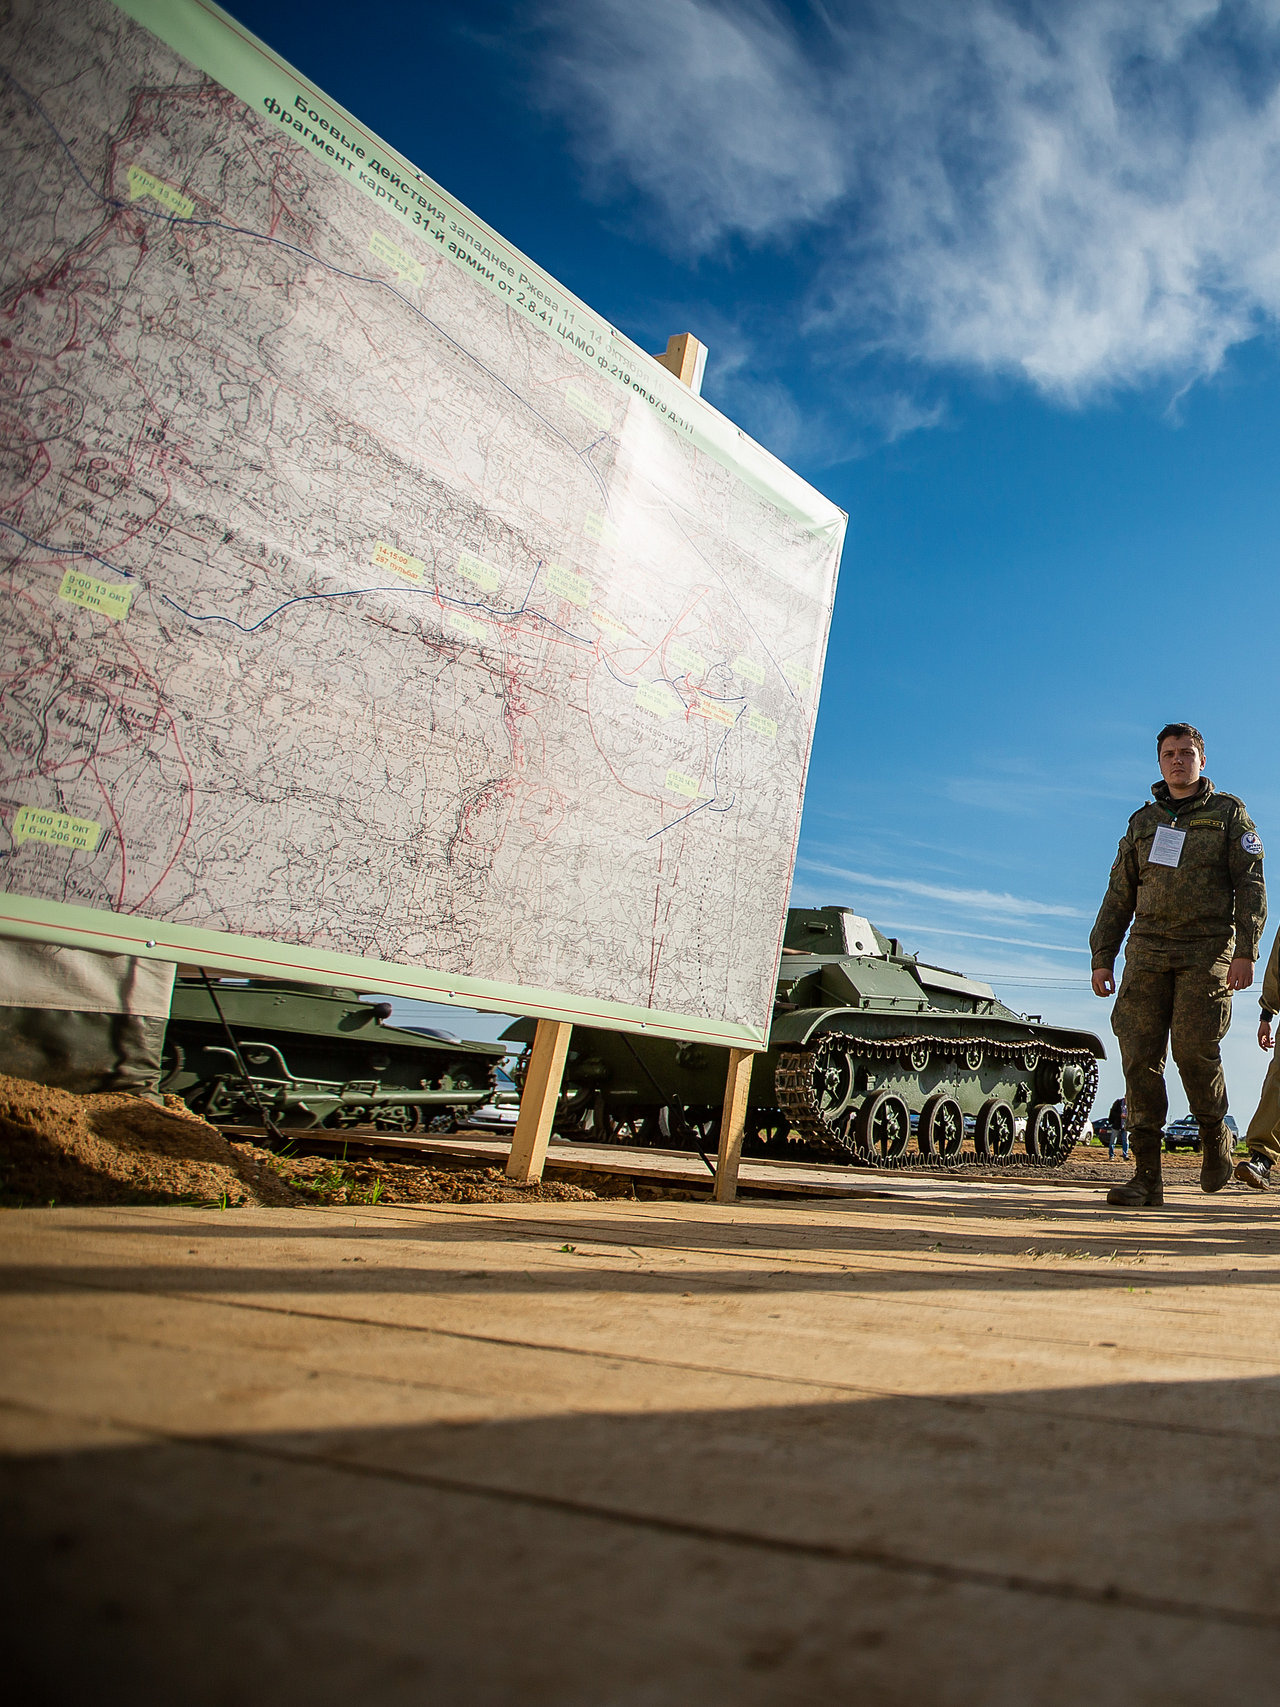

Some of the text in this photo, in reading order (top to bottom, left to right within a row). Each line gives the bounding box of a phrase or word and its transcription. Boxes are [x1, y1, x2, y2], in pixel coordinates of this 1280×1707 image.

[293, 94, 366, 159] Боевые
[368, 158, 447, 223] действия
[448, 220, 515, 278] западнее
[518, 271, 560, 312] Ржева
[562, 308, 576, 326] 11
[589, 330, 603, 346] 14
[604, 343, 650, 383] октября
[263, 96, 356, 172] фрагмент
[358, 169, 409, 216] карты
[411, 210, 446, 244] 31-й
[447, 241, 495, 282] армии
[497, 279, 516, 296] от
[516, 291, 555, 328] 2.8.41
[556, 323, 596, 359] ЦАМО
[596, 355, 632, 385] ф.219
[632, 382, 668, 414] оп.679
[375, 552, 389, 565] 297
[377, 545, 409, 566] 14-15:00
[65, 585, 102, 607] 312 пп
[68, 574, 127, 604] 9:00 13 окт
[24, 811, 91, 835] 11:00 13 окт
[50, 829, 70, 842] 206
